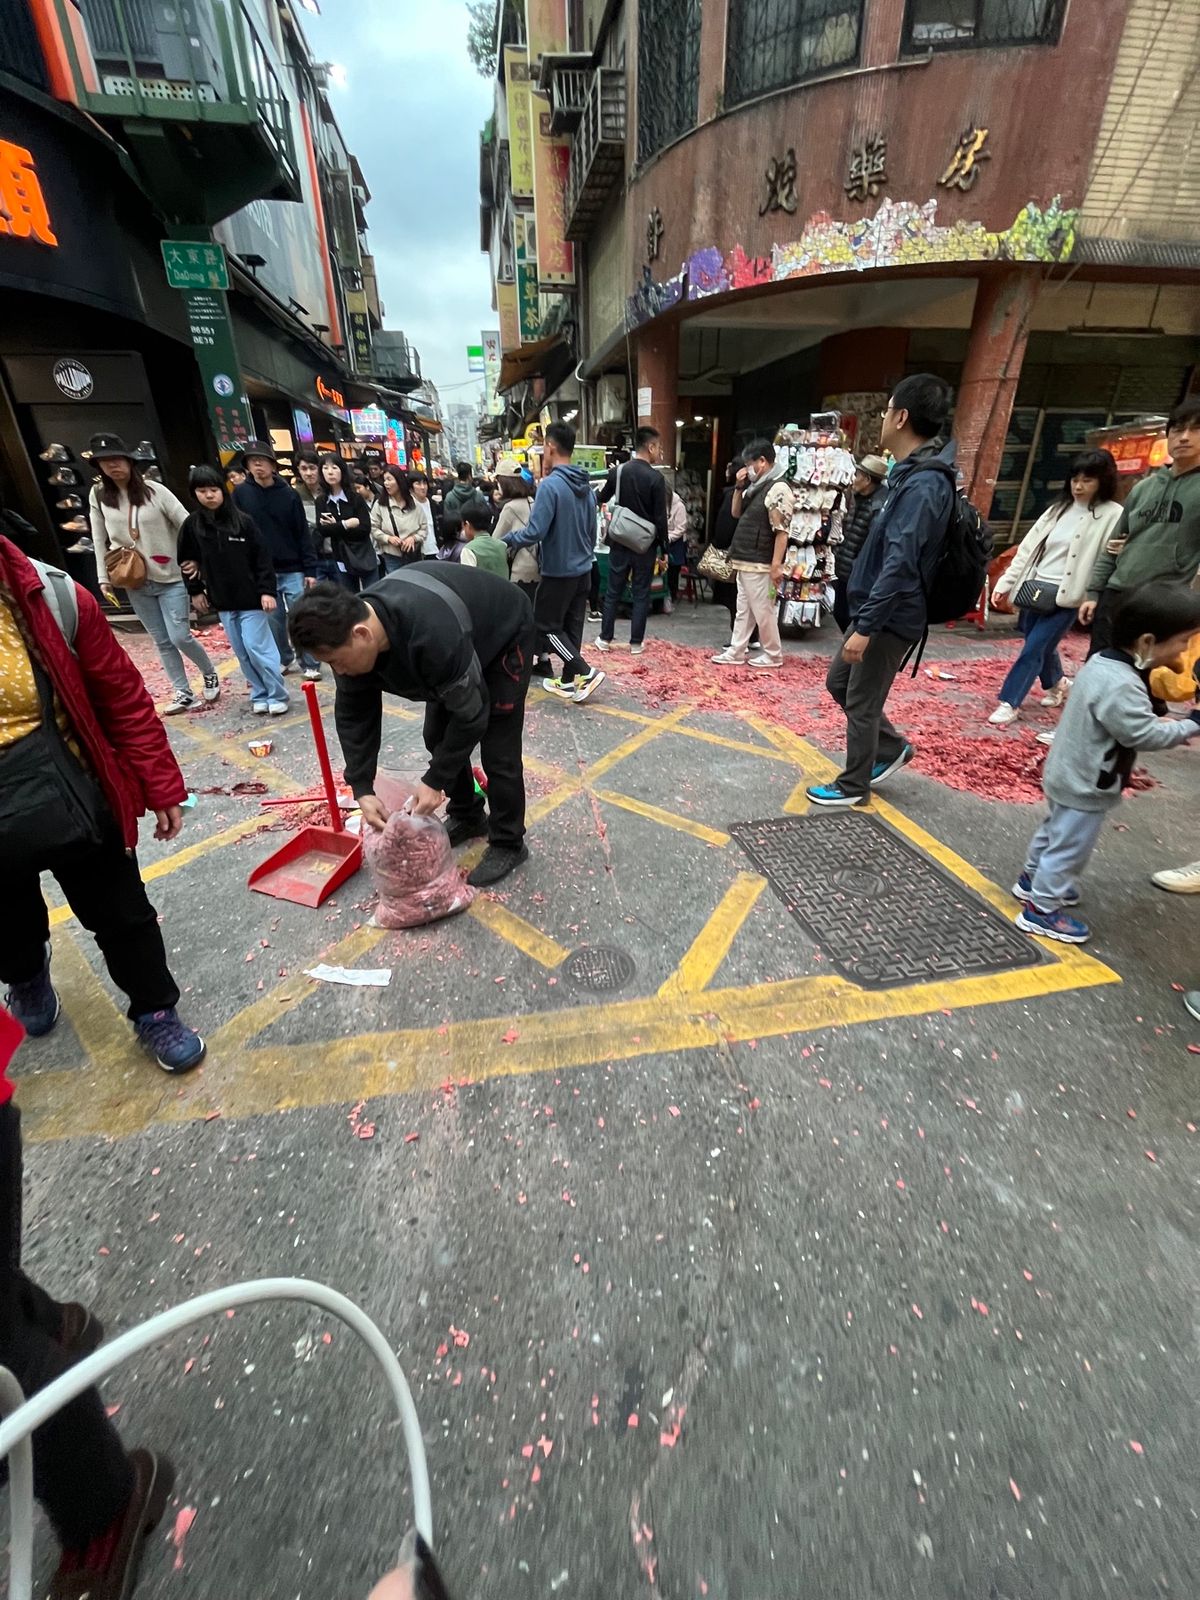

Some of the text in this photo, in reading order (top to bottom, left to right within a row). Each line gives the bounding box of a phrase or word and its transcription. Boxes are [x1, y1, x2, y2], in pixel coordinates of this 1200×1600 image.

[168, 248, 218, 266] 大東路
[173, 269, 205, 283] DaDong
